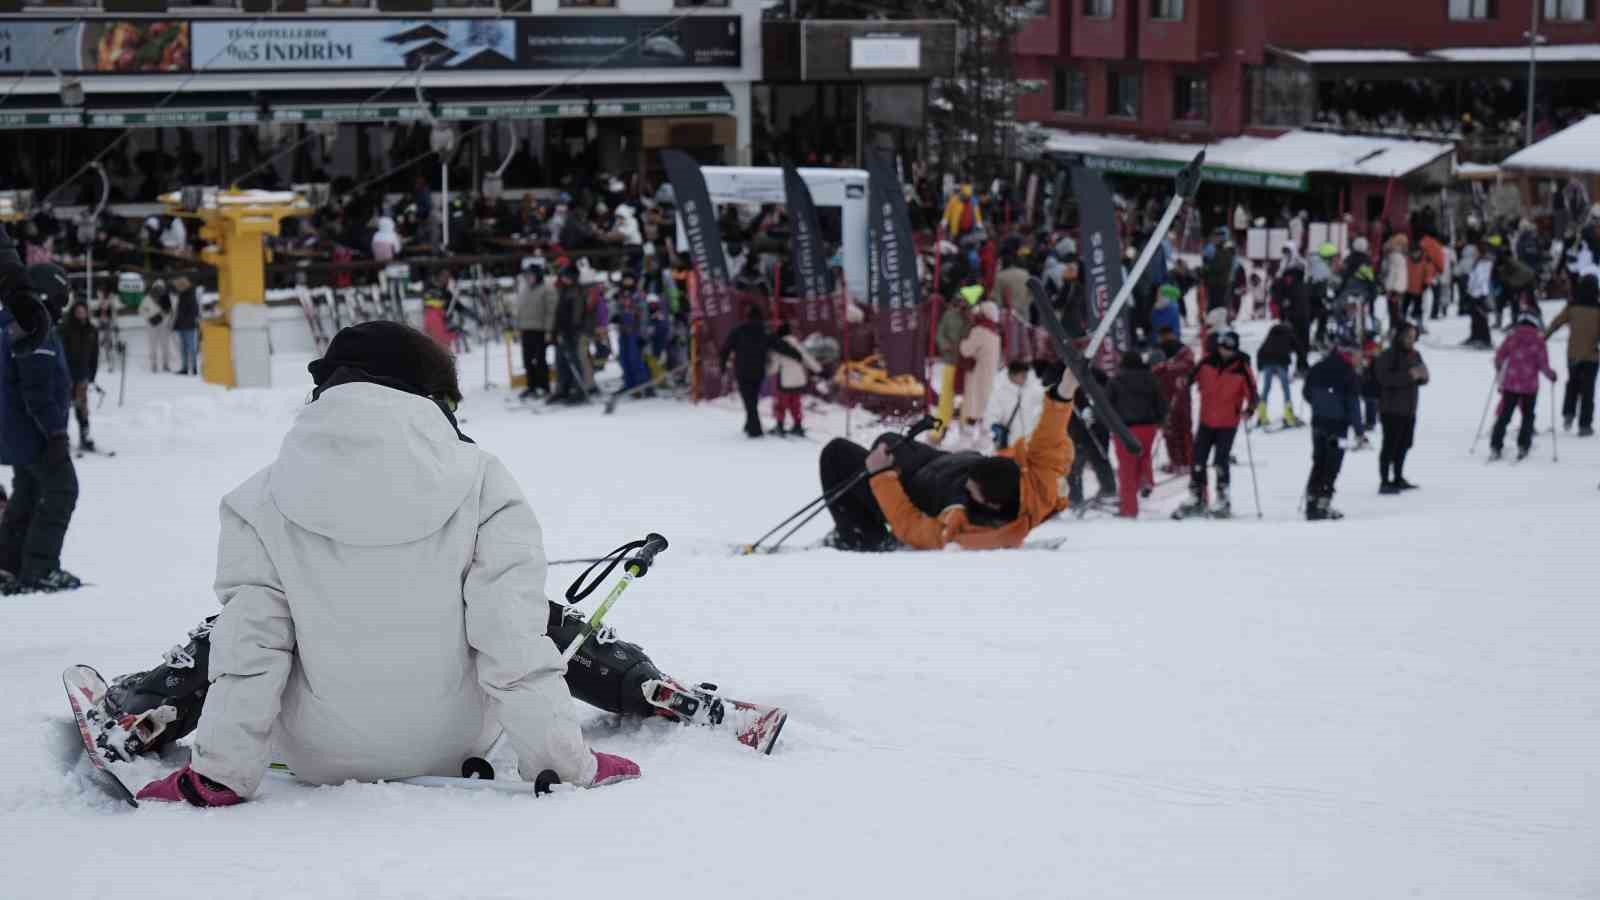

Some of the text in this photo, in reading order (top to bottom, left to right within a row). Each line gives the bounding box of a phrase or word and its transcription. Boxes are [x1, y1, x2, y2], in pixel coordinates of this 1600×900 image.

[257, 28, 328, 39] OTELLERDE
[265, 41, 352, 60] İNDİRİM
[881, 203, 903, 333] maximiles
